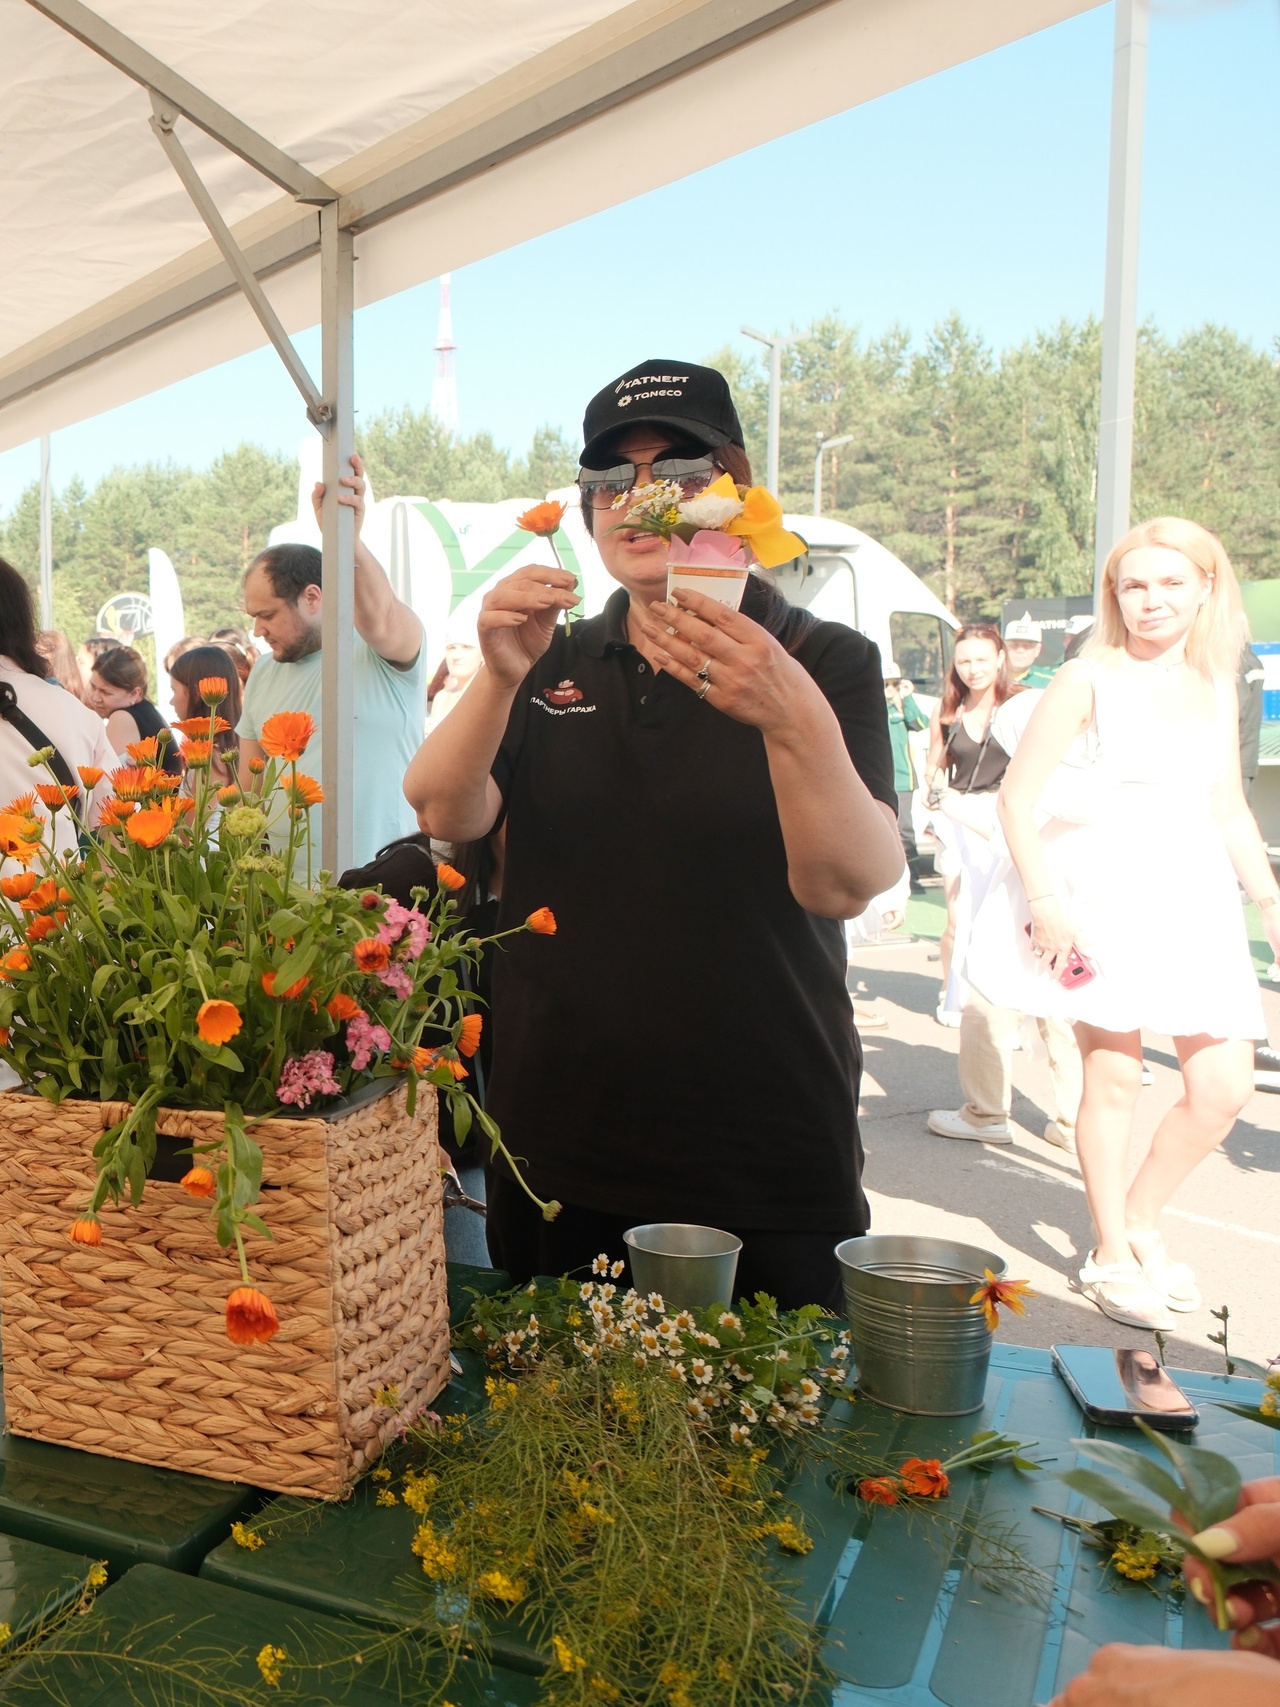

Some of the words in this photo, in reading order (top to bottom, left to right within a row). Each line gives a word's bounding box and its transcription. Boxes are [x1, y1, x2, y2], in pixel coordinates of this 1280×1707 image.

[624, 375, 689, 389] TATNEFT
[530, 697, 566, 715] ПАРТНЕРЫ
[567, 705, 596, 713] ГАРАЖА
